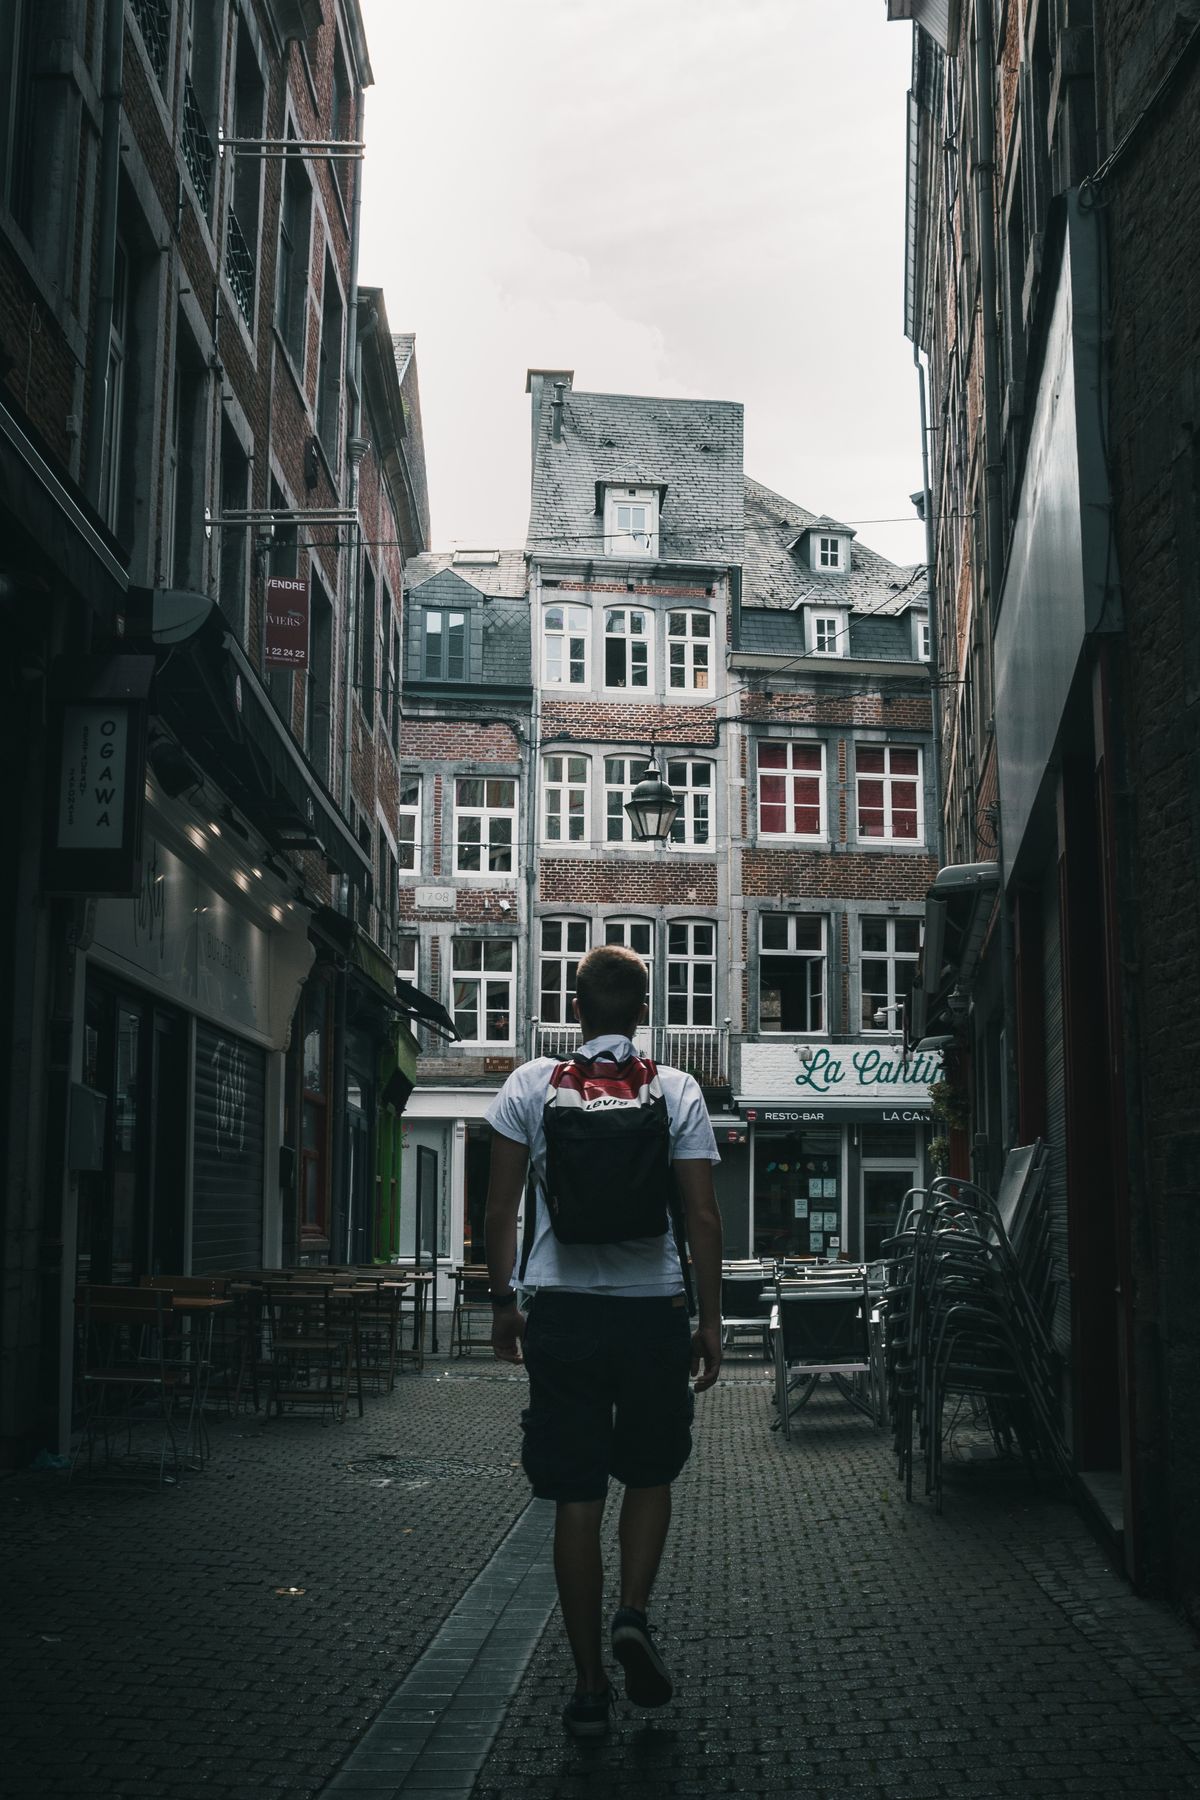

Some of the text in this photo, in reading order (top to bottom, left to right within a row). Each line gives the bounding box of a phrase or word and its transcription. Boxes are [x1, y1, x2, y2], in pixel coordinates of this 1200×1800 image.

[272, 647, 282, 655] 22
[284, 648, 294, 657] 24
[295, 650, 305, 658] 22
[95, 720, 116, 827] OGAWA
[422, 891, 450, 903] 1708
[796, 1049, 846, 1092] La
[764, 1112, 825, 1121] RESTO-BAR
[882, 1111, 900, 1121] LA
